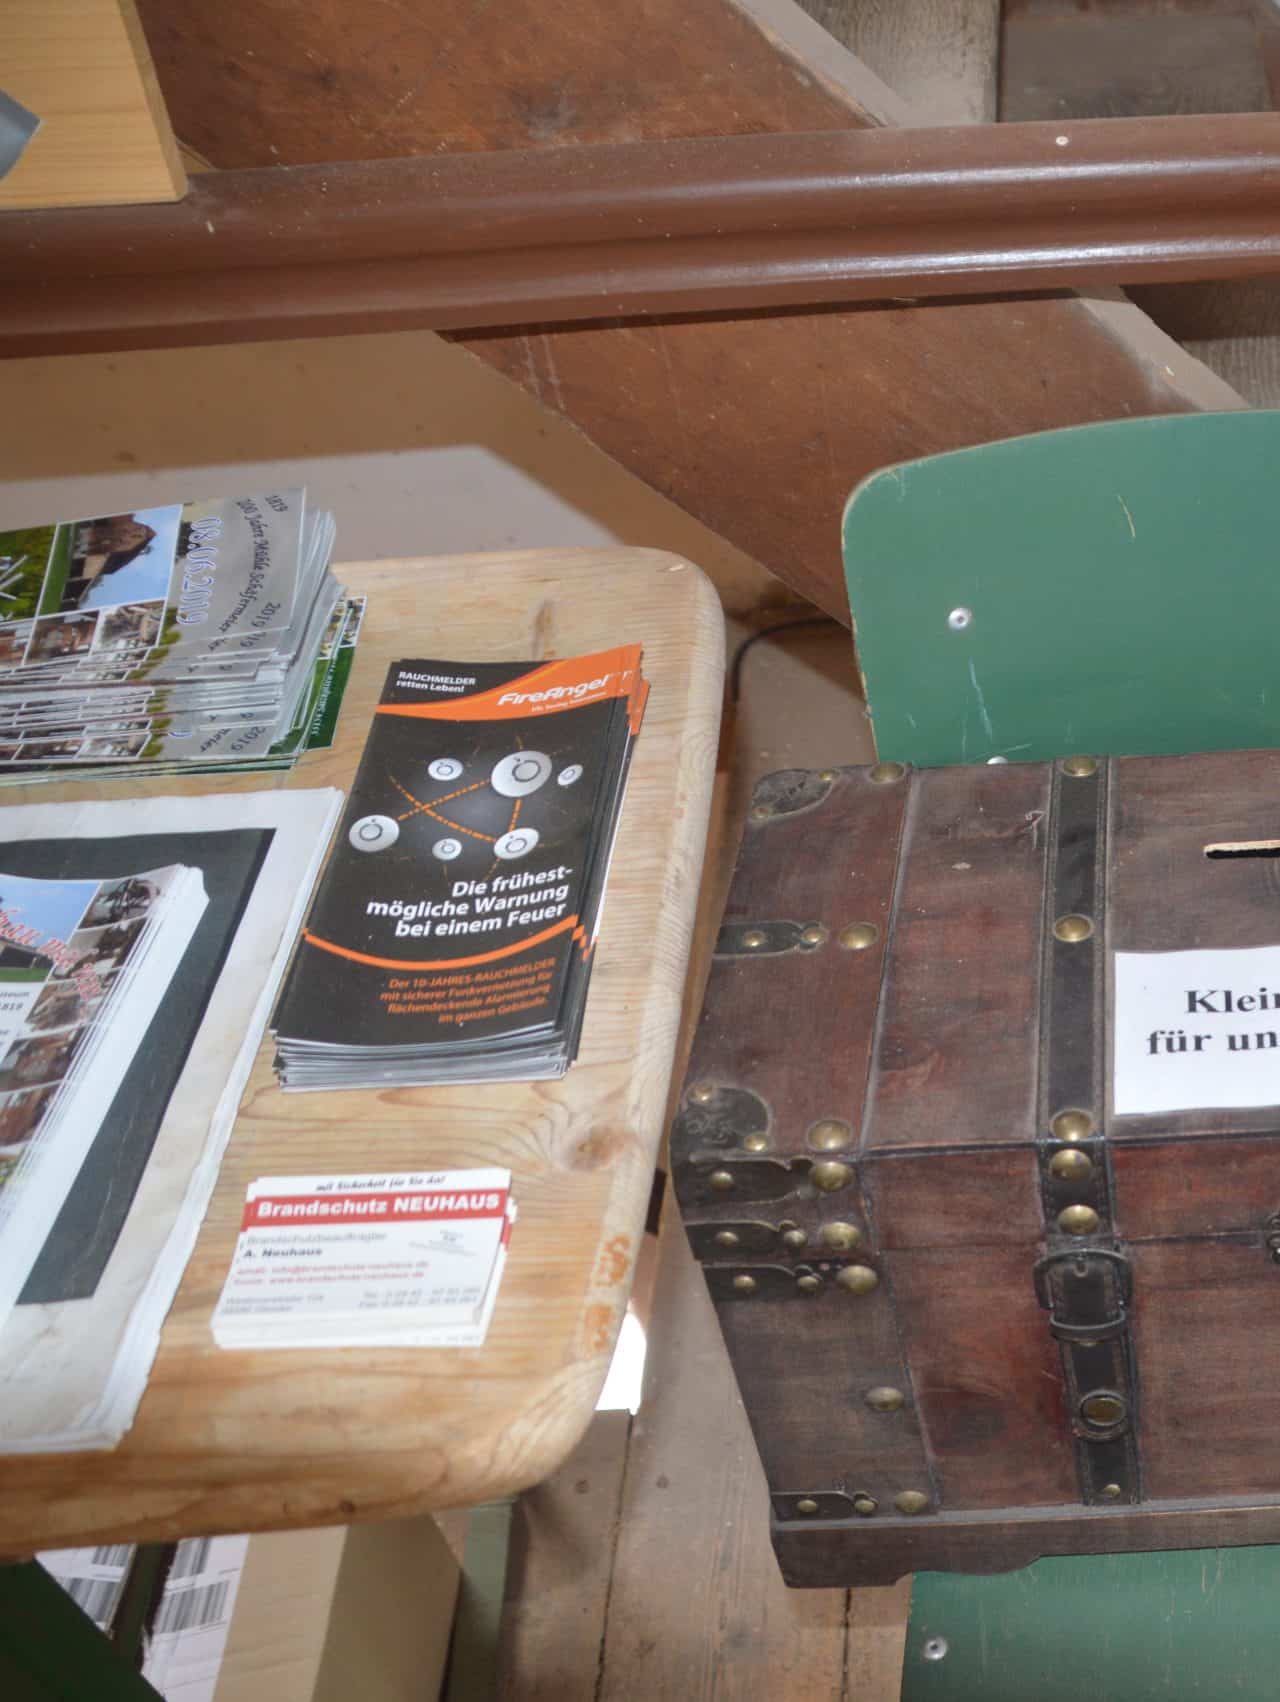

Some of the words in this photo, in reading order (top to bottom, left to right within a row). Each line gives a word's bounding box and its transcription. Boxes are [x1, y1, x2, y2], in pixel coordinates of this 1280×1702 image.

[244, 513, 268, 538] Jahre
[254, 540, 271, 570] Mühle
[176, 515, 222, 625] 08.06.2019
[252, 602, 281, 628] 2019
[396, 679, 429, 690] retten
[430, 682, 465, 693] Leben!
[398, 671, 477, 686] RAUCHMELDER
[497, 674, 609, 705] FireAngel
[452, 881, 487, 898] Die
[491, 866, 573, 894] frühest-
[366, 899, 469, 921] mögliche
[475, 884, 569, 914] Warnung
[395, 919, 430, 937] bei
[434, 916, 501, 936] einem
[506, 903, 567, 928] Feuer
[380, 991, 400, 1001] mit
[388, 978, 409, 989] Der
[1146, 1029, 1213, 1055] für
[315, 1183, 333, 1192] mit
[337, 1179, 386, 1191] Sicherheit
[409, 1176, 424, 1185] Sie
[257, 1198, 388, 1218] Brandschutz
[393, 1194, 500, 1214] NEUHAUS
[262, 1248, 323, 1257] Neuhaus
